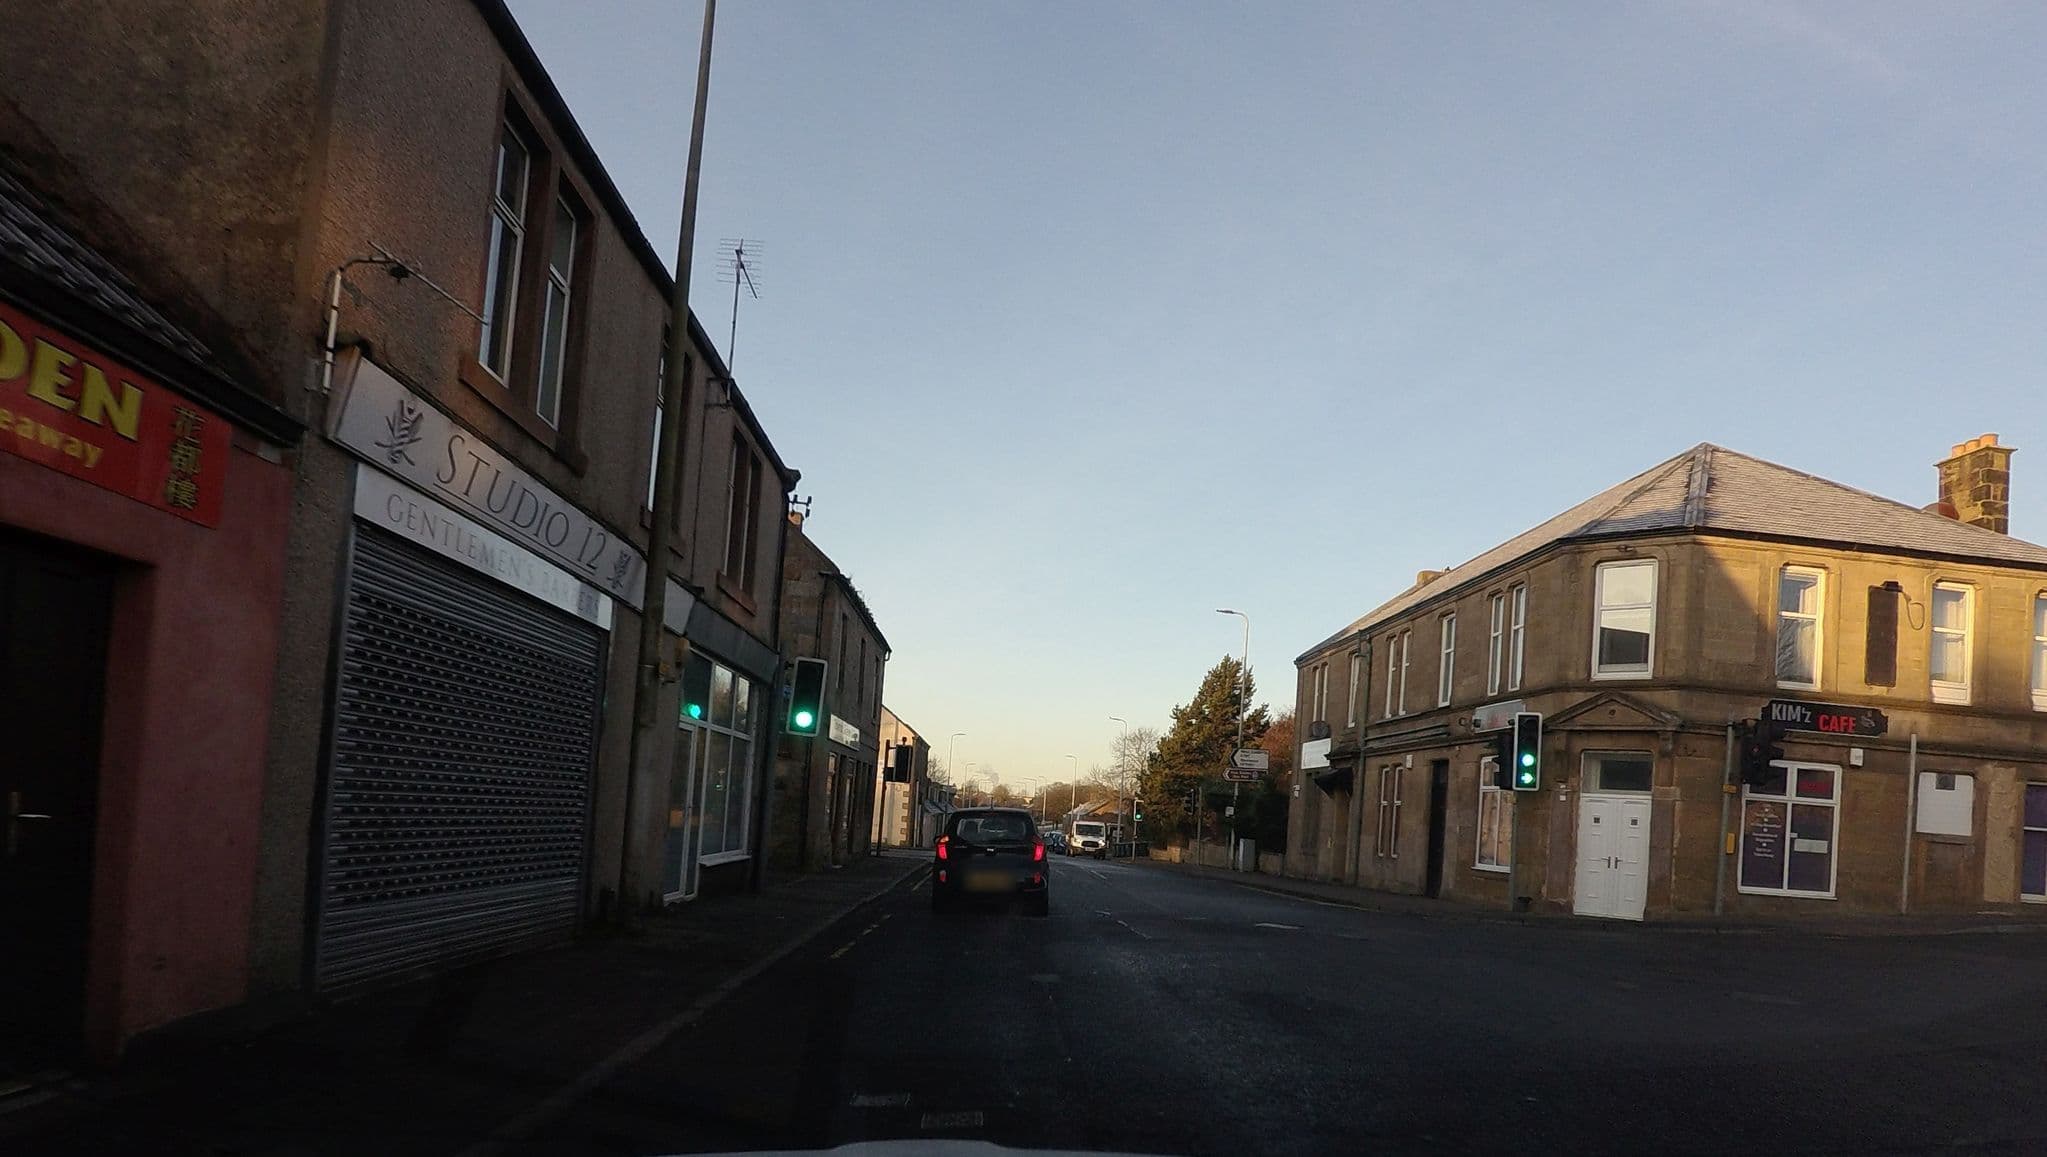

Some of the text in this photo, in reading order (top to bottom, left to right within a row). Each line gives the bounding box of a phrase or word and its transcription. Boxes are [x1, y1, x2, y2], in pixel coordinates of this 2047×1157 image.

[436, 434, 606, 570] STUDIO 12
[542, 570, 599, 619] BARERS
[1818, 713, 1857, 733] CAFE
